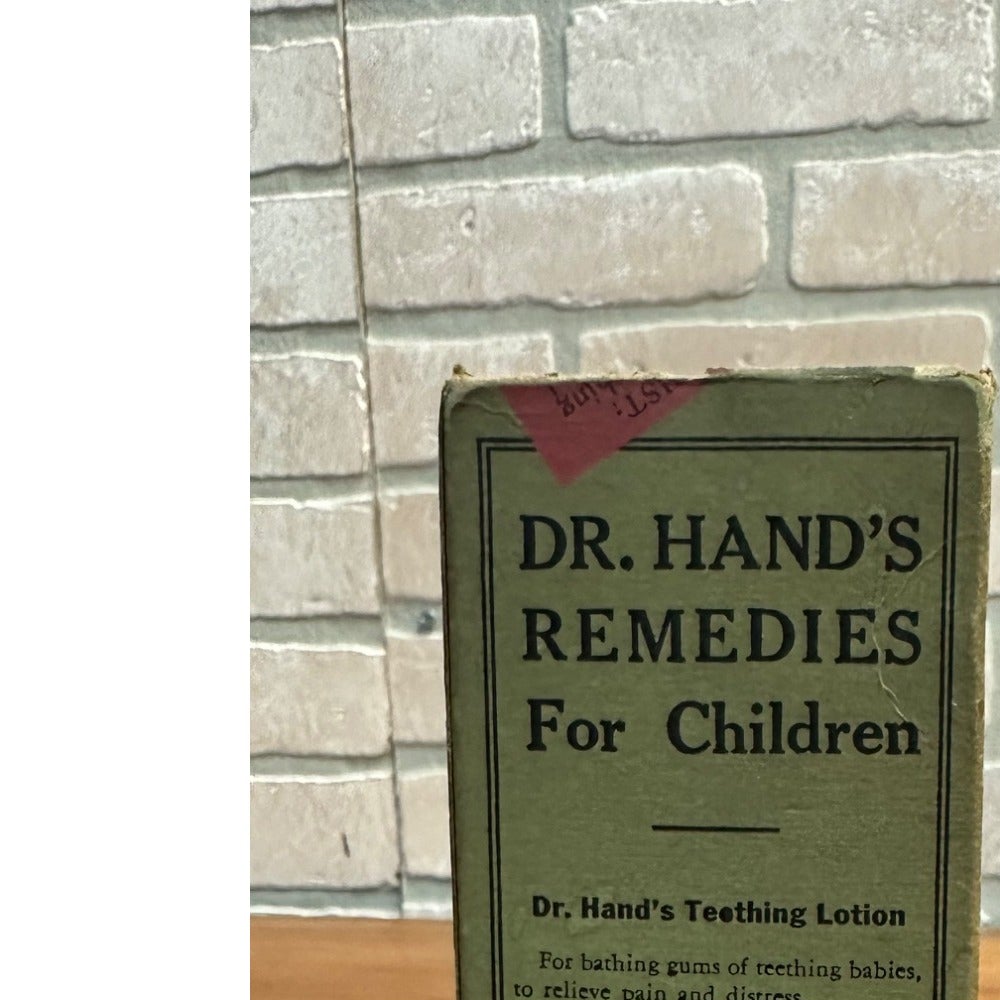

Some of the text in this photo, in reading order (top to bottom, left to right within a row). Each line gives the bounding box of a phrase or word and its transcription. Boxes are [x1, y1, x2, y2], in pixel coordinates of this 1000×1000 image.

[518, 513, 923, 574] DR. HAND'S
[521, 607, 922, 667] REMEDIES
[525, 698, 922, 756] For Children
[532, 895, 906, 929] Dr. Hand's Teething Lotion
[538, 950, 922, 983] For bathing gums of teething babies,
[513, 983, 534, 998] to
[543, 980, 611, 1000] relieve
